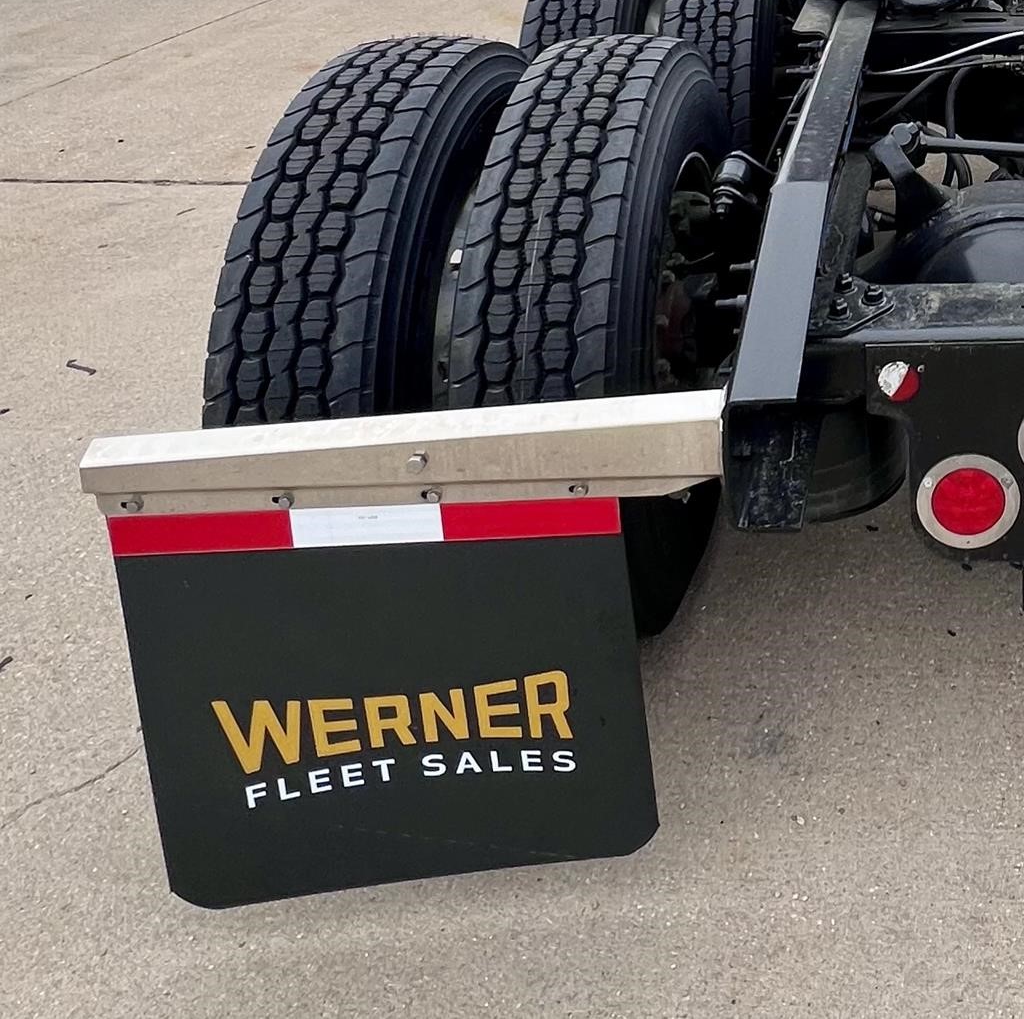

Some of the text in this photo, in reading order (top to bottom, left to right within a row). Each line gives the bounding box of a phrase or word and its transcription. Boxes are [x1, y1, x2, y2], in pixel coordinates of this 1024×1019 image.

[211, 670, 574, 774] WERNER
[245, 750, 578, 810] FLEET SALES
